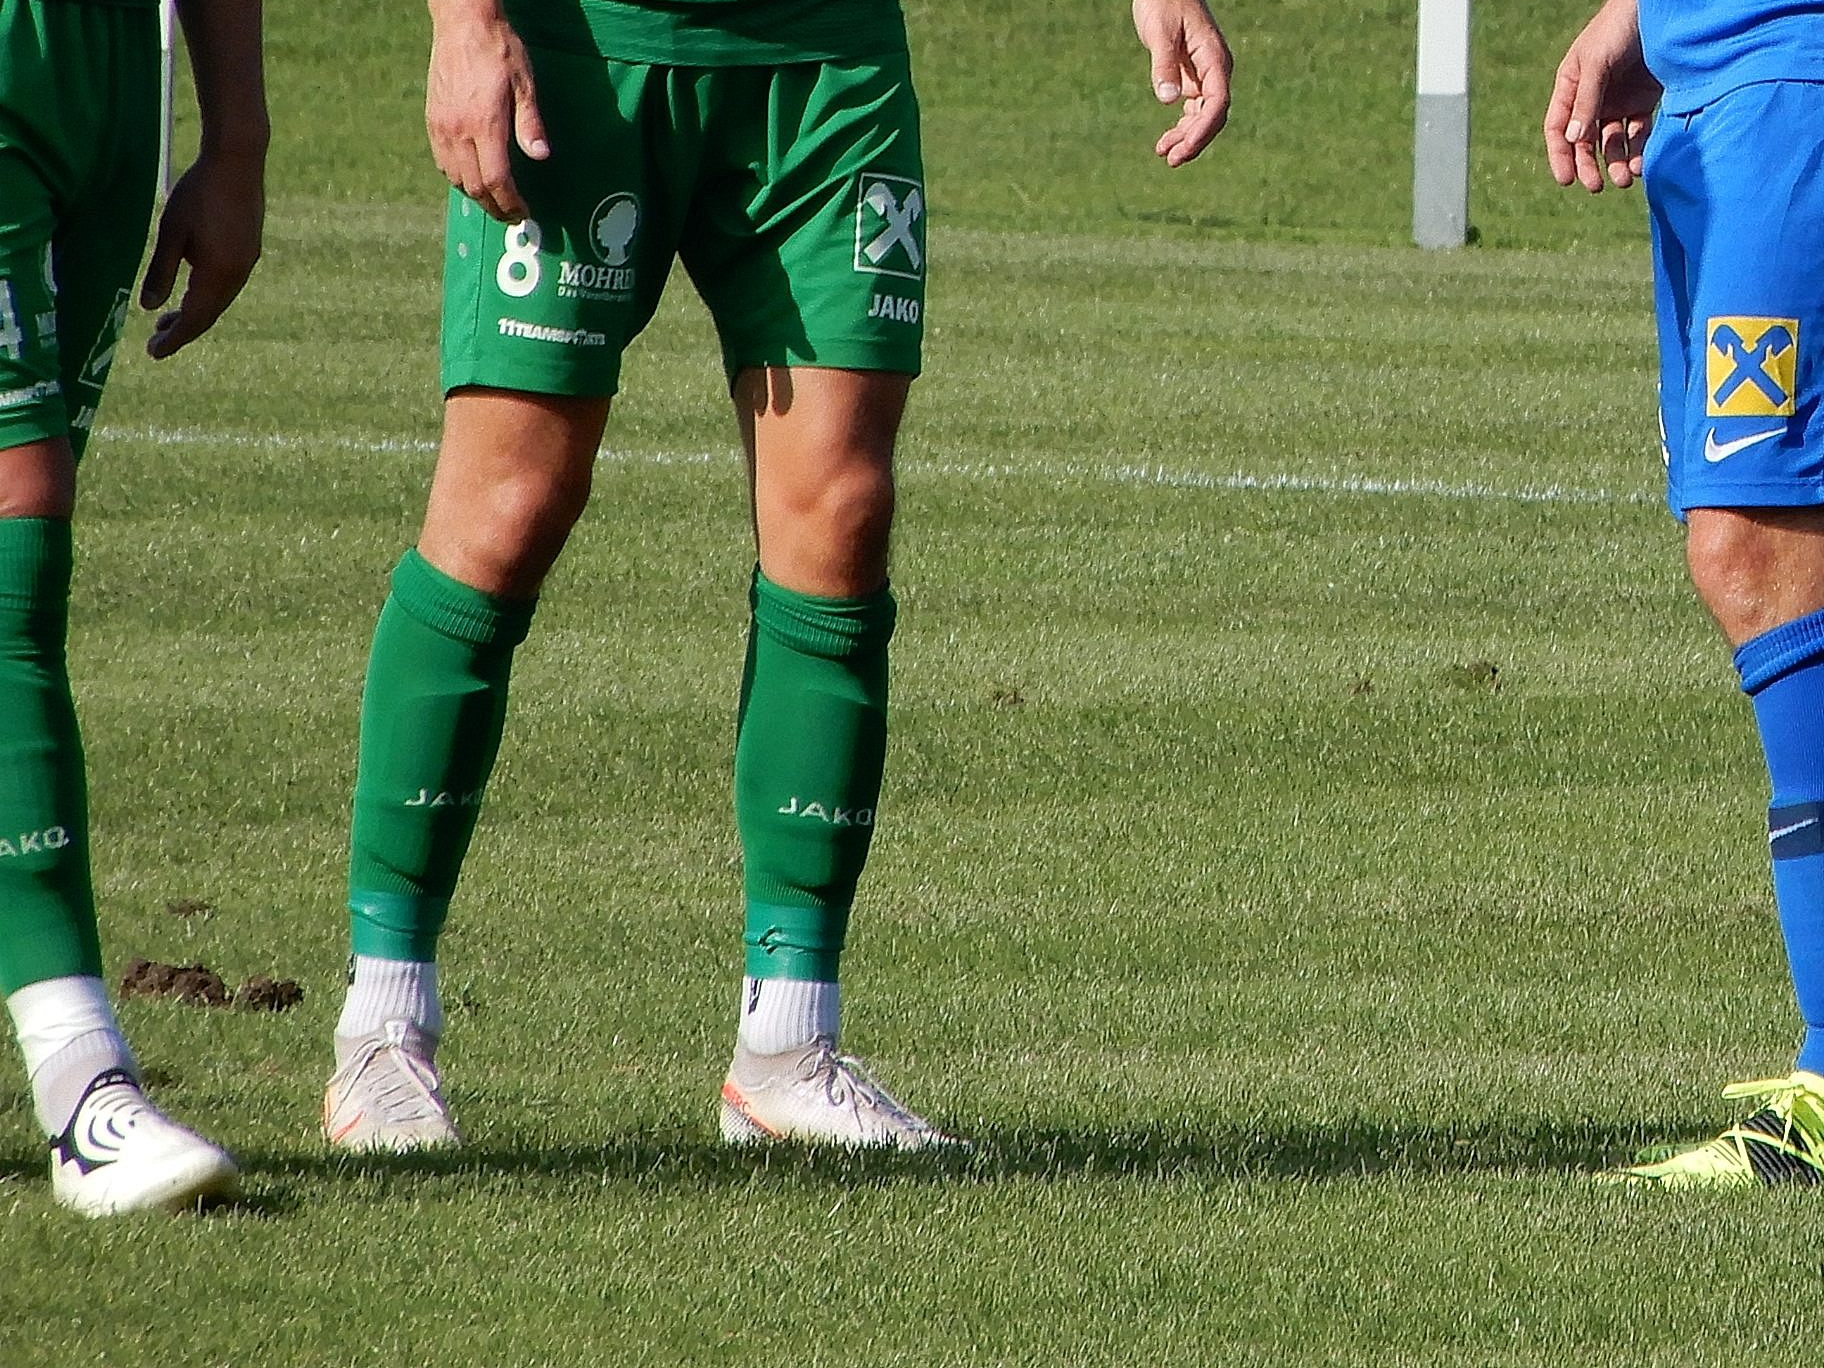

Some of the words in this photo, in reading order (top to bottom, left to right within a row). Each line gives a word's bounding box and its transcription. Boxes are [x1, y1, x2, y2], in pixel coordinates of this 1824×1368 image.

[496, 218, 542, 297] 8
[868, 294, 919, 324] JAKO
[779, 797, 872, 827] JAKO
